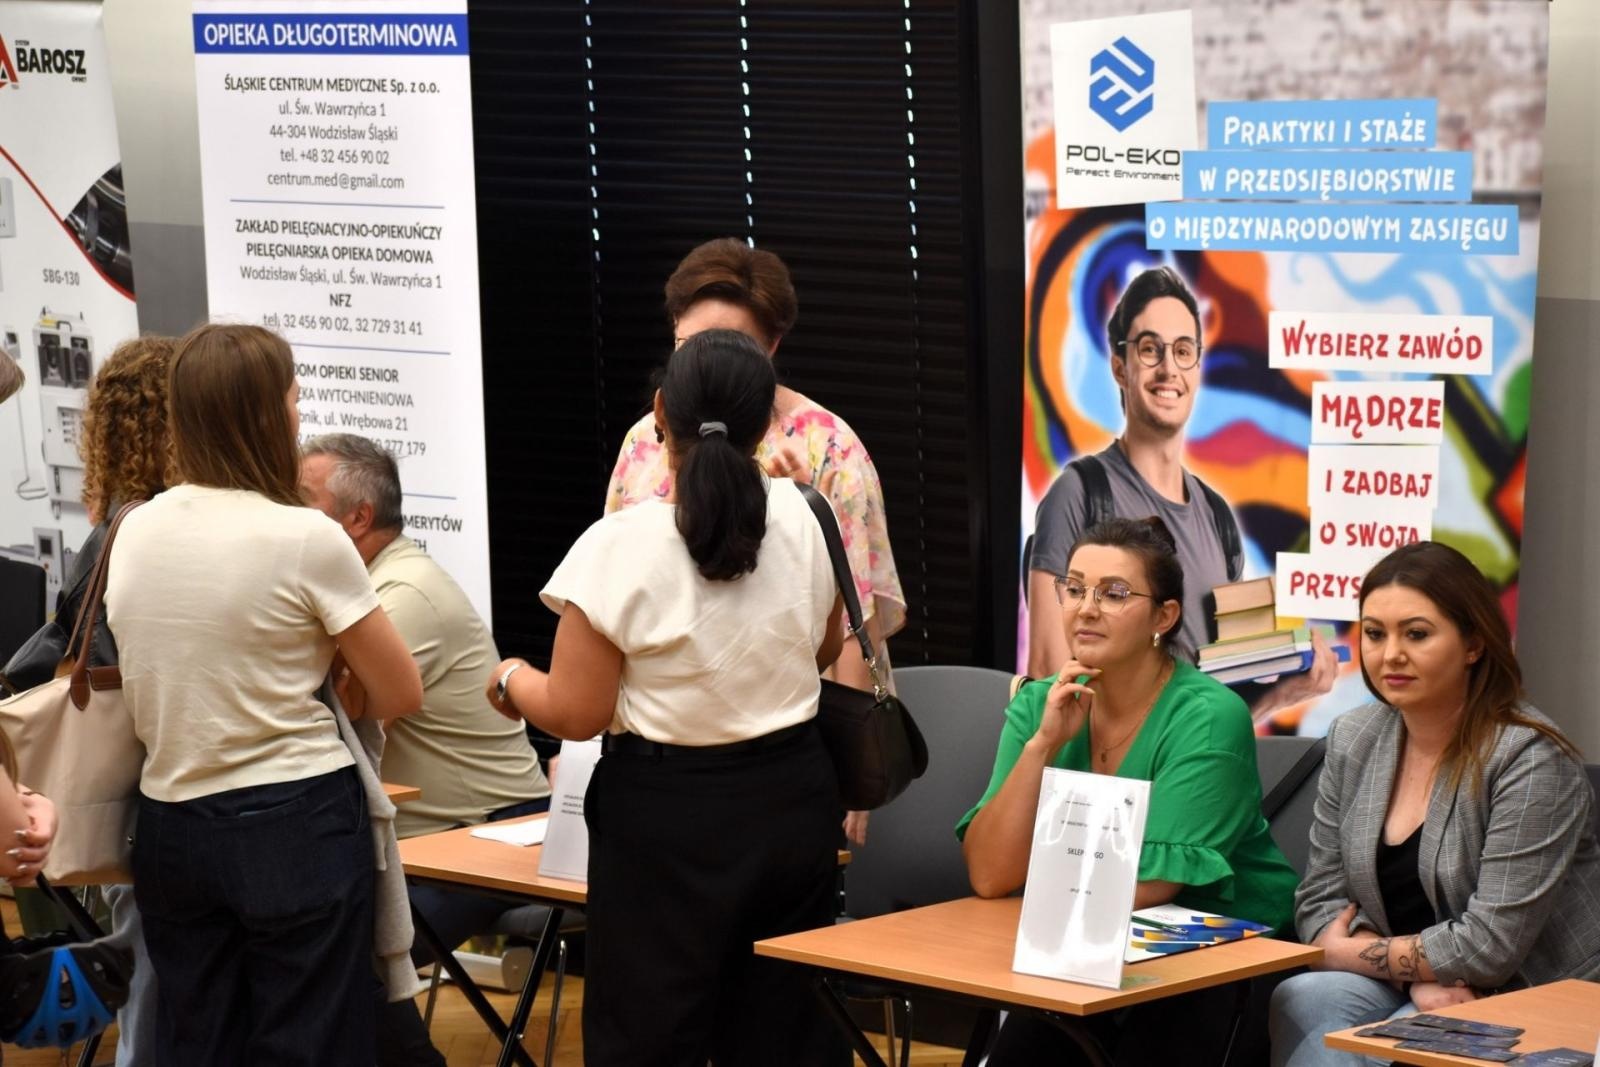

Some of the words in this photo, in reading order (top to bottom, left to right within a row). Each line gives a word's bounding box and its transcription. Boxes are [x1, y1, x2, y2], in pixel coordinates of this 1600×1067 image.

[204, 23, 269, 46] OPIEKA
[273, 23, 458, 47] DŁUGOTERMINOWA
[16, 47, 87, 75] BAROSZ
[224, 73, 267, 93] ŚLĄSKIE
[269, 77, 324, 91] CENTRUM
[326, 78, 388, 92] MEDYCZNE
[390, 79, 408, 95] Sp.
[410, 82, 416, 93] z
[419, 82, 440, 93] o.o.
[279, 99, 293, 115] ul.
[295, 97, 313, 116] Św.
[315, 101, 377, 119] Wawrzyńca
[380, 102, 386, 117] 1
[269, 124, 307, 138] 44-304
[308, 124, 366, 141] Wodzisław
[368, 122, 399, 144] Śląski
[280, 147, 298, 163] tel.
[300, 148, 319, 163] +48
[321, 148, 335, 164] 32
[337, 149, 358, 164] 456
[360, 150, 374, 165] 90
[375, 150, 390, 165] 02
[1066, 144, 1181, 166] POL-EKO
[267, 172, 405, 191] centrum.med@gmail.com
[1066, 166, 1111, 178] Perfect
[1113, 169, 1181, 182] Environment
[235, 218, 279, 234] ZAKŁAD
[281, 220, 443, 241] PIELĘGNACYJNO-OPIEKUŃCZY
[246, 242, 330, 261] PIELĘGNIARSKA
[331, 246, 374, 262] OPIEKA
[375, 248, 434, 264] DOMOWA
[42, 268, 80, 287] SBG-130
[239, 264, 298, 281] Wodzisław
[299, 265, 331, 286] Śląski,
[332, 269, 347, 284] ul.
[349, 267, 369, 286] Św.
[370, 271, 433, 291] Wawrzyńca
[435, 274, 443, 289] 1
[329, 293, 352, 308] NFZ
[283, 314, 297, 327] 32
[298, 314, 317, 329] 456
[318, 316, 333, 330] 90
[355, 318, 369, 333] 32
[371, 318, 391, 334] 729
[393, 320, 407, 335] 31
[408, 321, 422, 336] 41
[319, 364, 357, 381] OPIEKI
[359, 367, 399, 383] SENIOR
[317, 388, 415, 408] WYTCHNIENIOWA
[324, 411, 338, 426] ul.
[340, 413, 393, 431] Wrębowa
[395, 417, 409, 432] 21
[1320, 393, 1442, 439] MĄDRZE
[406, 441, 427, 456] 179
[1342, 469, 1433, 498] ZADBAJ
[402, 514, 463, 533] MERYTÓW
